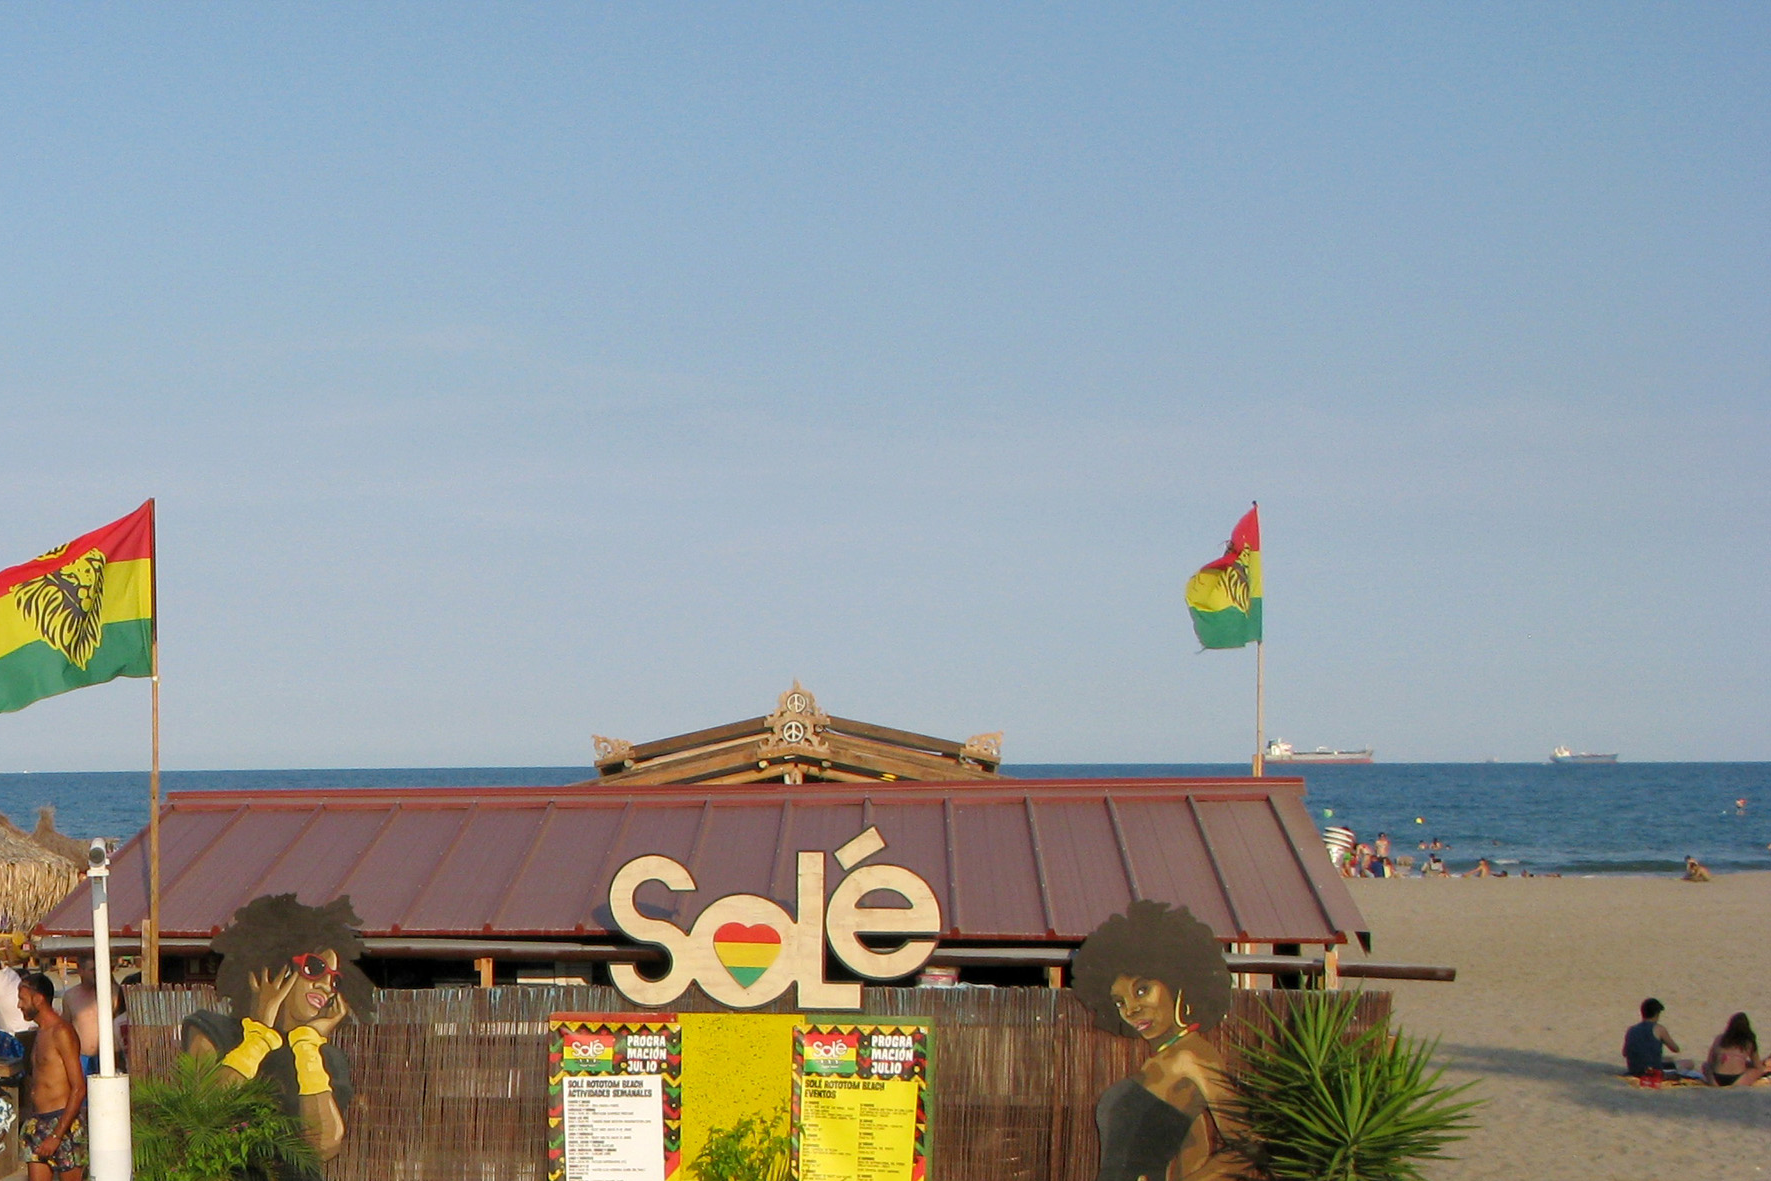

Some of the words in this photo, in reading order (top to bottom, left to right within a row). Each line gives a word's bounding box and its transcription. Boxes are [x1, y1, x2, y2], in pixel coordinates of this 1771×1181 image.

[627, 1035, 666, 1047] PROGRA
[871, 1035, 913, 1048] PROGRA
[627, 1047, 667, 1059] MACIÓN
[871, 1047, 913, 1061] MACIÓN
[627, 1060, 658, 1072] JULIO
[871, 1061, 902, 1074] JULIO
